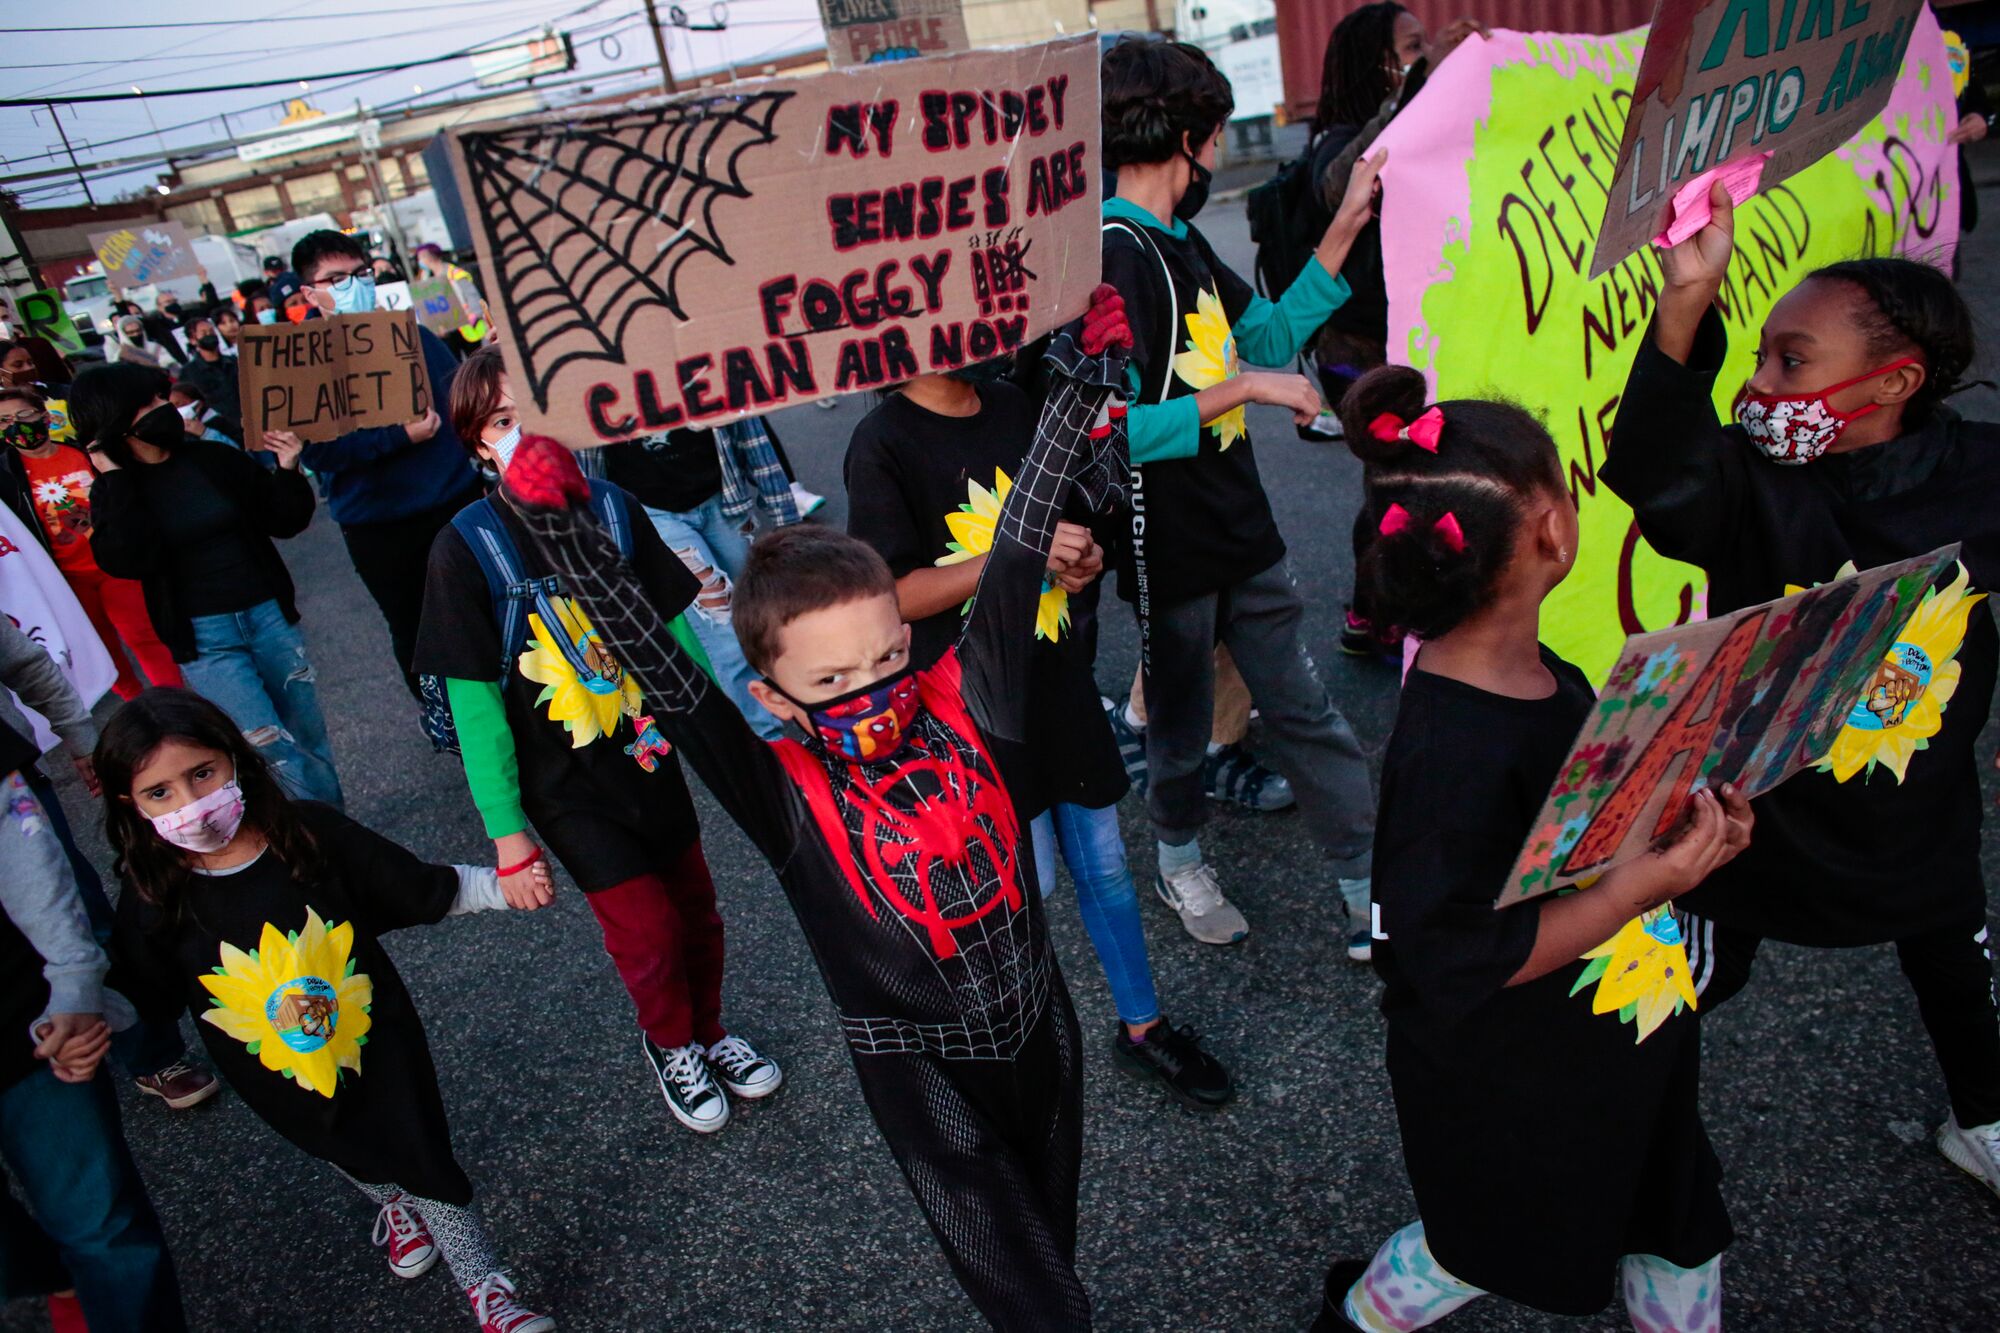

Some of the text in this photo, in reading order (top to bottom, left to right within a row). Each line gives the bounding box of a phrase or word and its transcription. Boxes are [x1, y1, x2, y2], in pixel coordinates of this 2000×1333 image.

[825, 74, 1069, 158] MY SPIDEY
[1627, 66, 1806, 218] LIMPIO
[826, 140, 1087, 253] SENSES ARE
[758, 248, 952, 338] FOGGY
[244, 329, 334, 369] THERE
[341, 323, 374, 356] IS
[586, 314, 1030, 442] CLEAN AIR NOW
[262, 361, 429, 432] PLANET B
